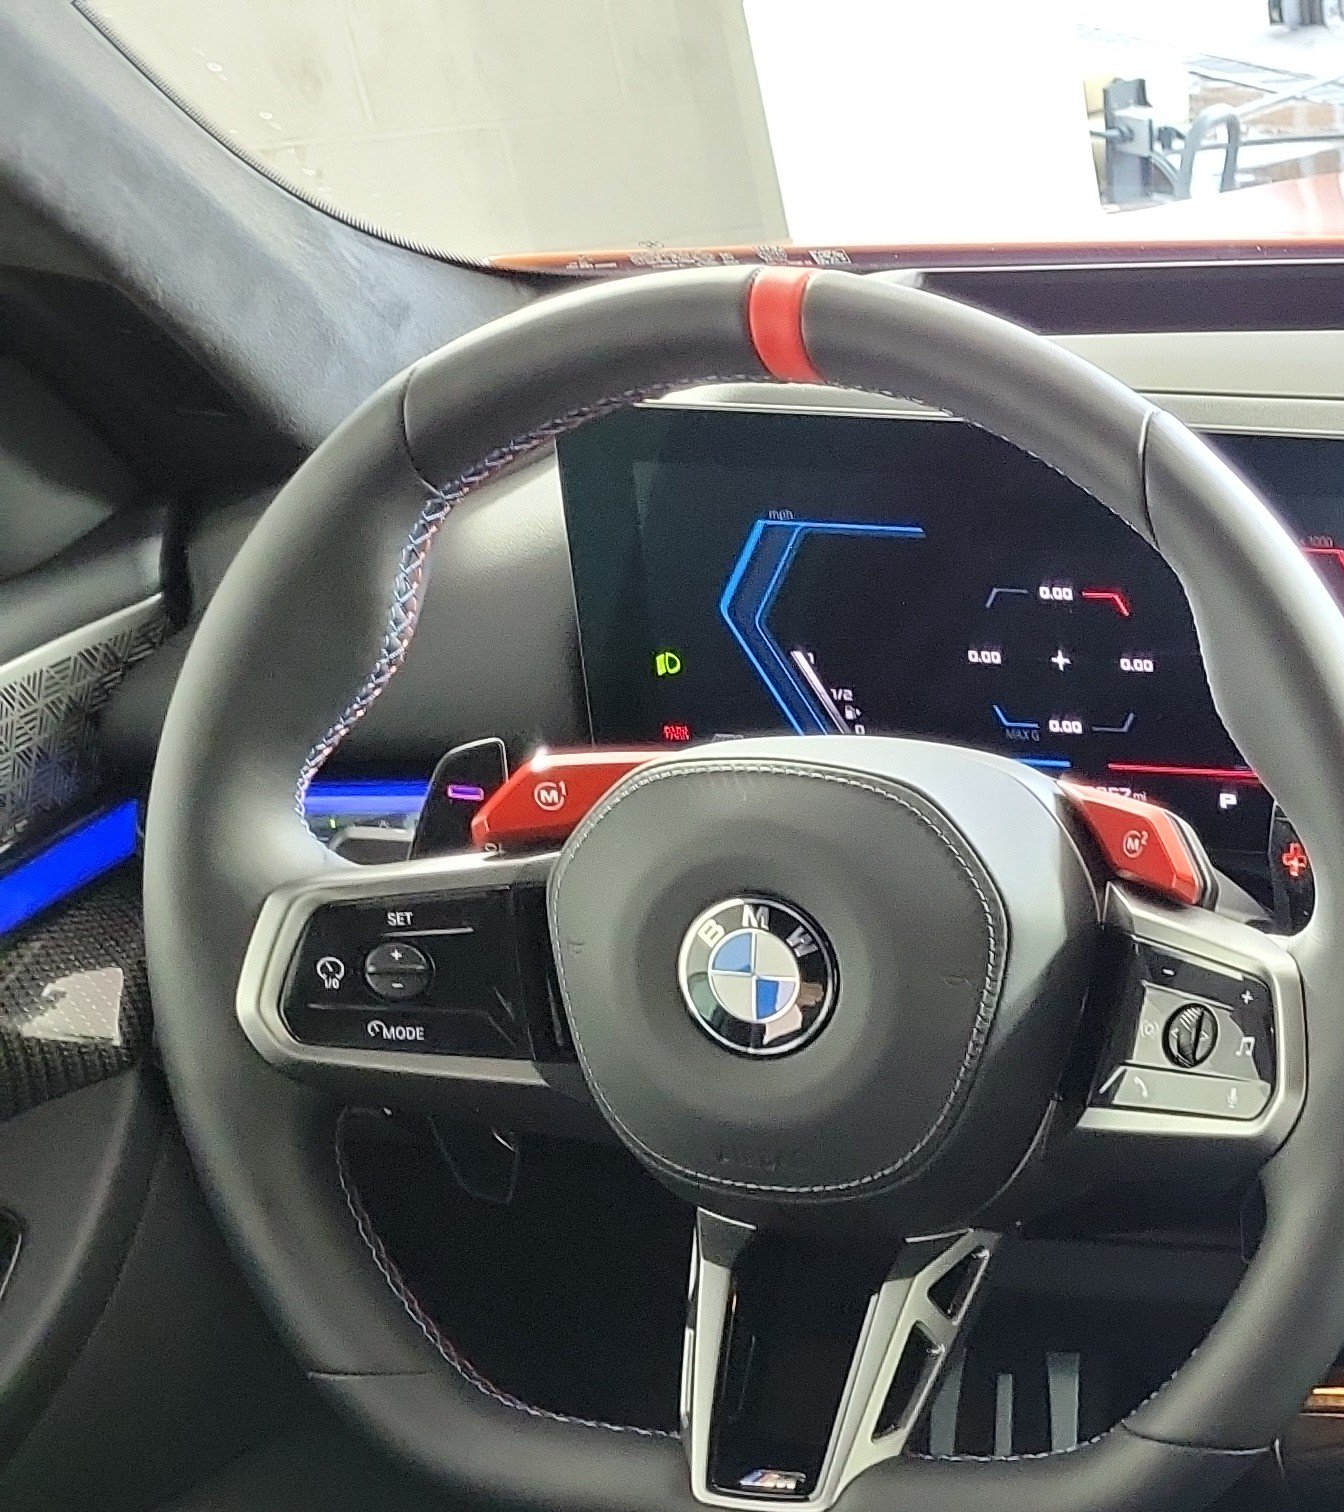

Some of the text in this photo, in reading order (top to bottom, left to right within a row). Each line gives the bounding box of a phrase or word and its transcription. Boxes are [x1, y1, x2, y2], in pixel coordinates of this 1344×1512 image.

[1039, 585, 1073, 601] 0.00
[968, 649, 1002, 665] 0.00
[1120, 657, 1154, 673] 0.00
[830, 688, 853, 702] 1/2
[1049, 719, 1083, 734] 0.00
[1219, 793, 1238, 809] P
[387, 911, 413, 927] SET
[697, 904, 819, 958] BMW
[382, 1026, 426, 1041] MODE
